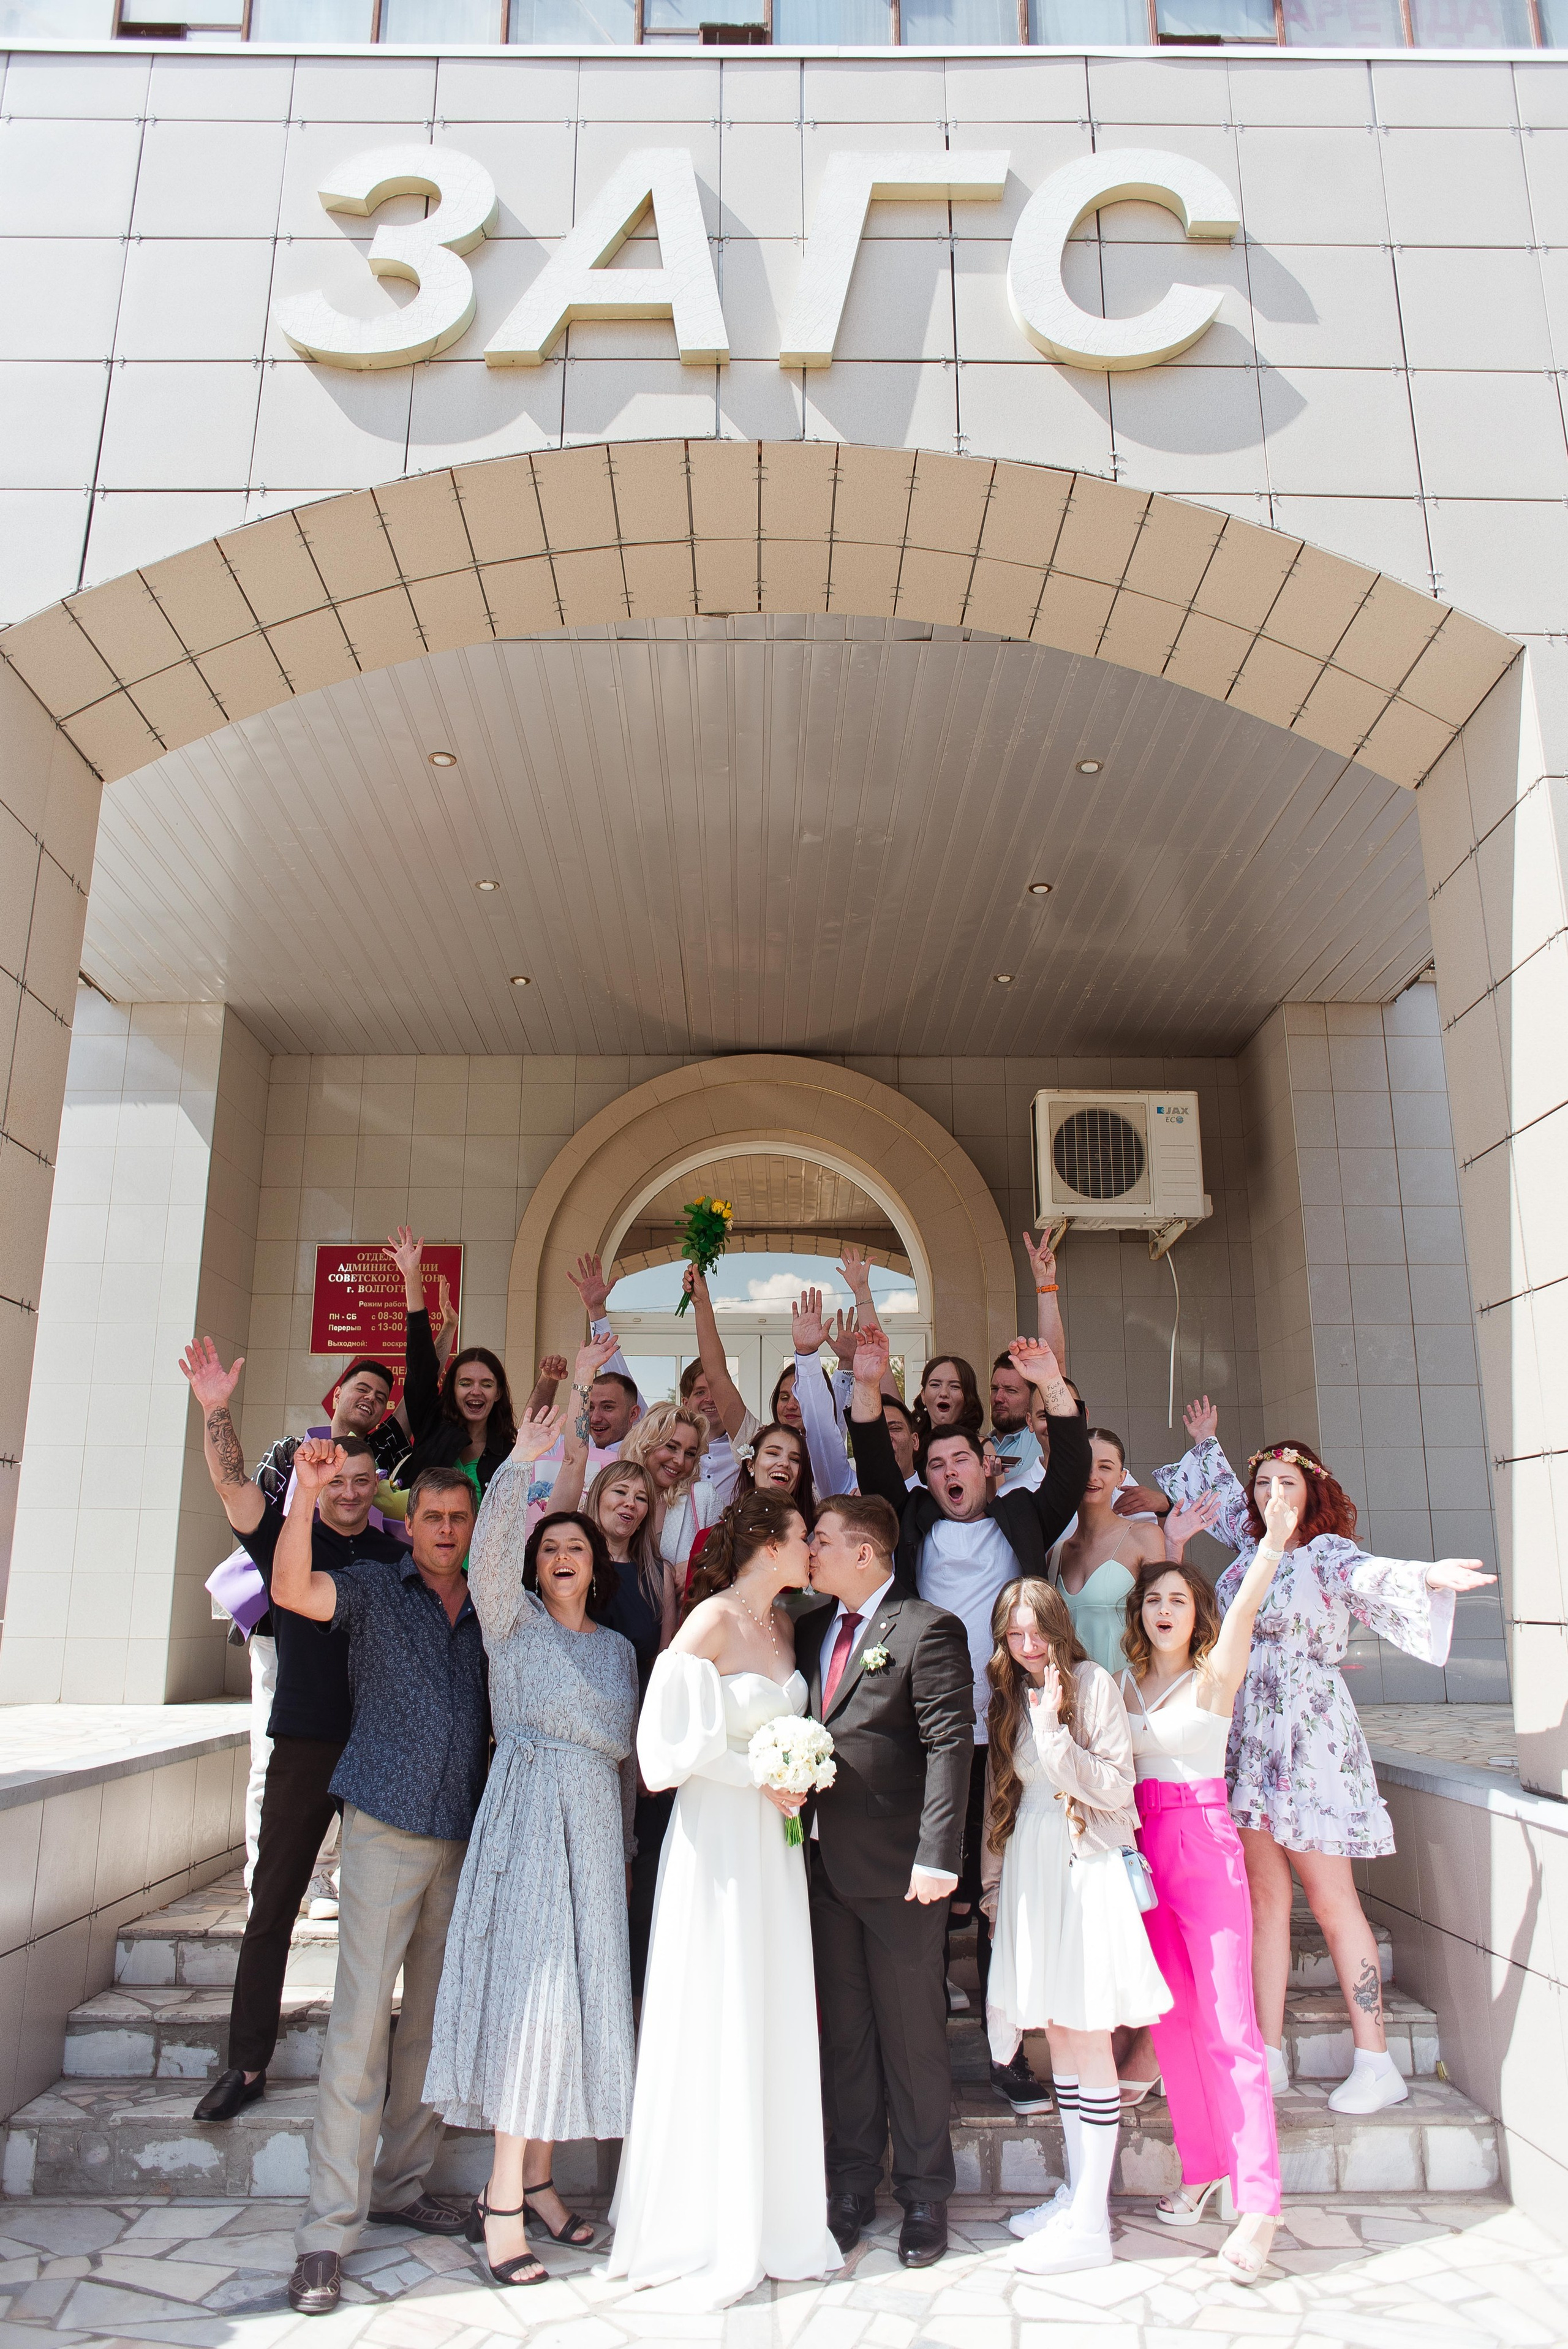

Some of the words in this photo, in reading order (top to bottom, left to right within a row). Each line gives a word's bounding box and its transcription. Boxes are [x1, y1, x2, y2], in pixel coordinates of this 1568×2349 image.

[272, 144, 1240, 371] ЗАГС
[337, 1263, 439, 1273] АДМИНИСТИИ
[328, 1273, 400, 1283] СОВЕТСКОГО
[358, 1284, 427, 1293] ВОЛГОГРА
[378, 1311, 403, 1320] 08-30
[378, 1322, 402, 1331] 13-00
